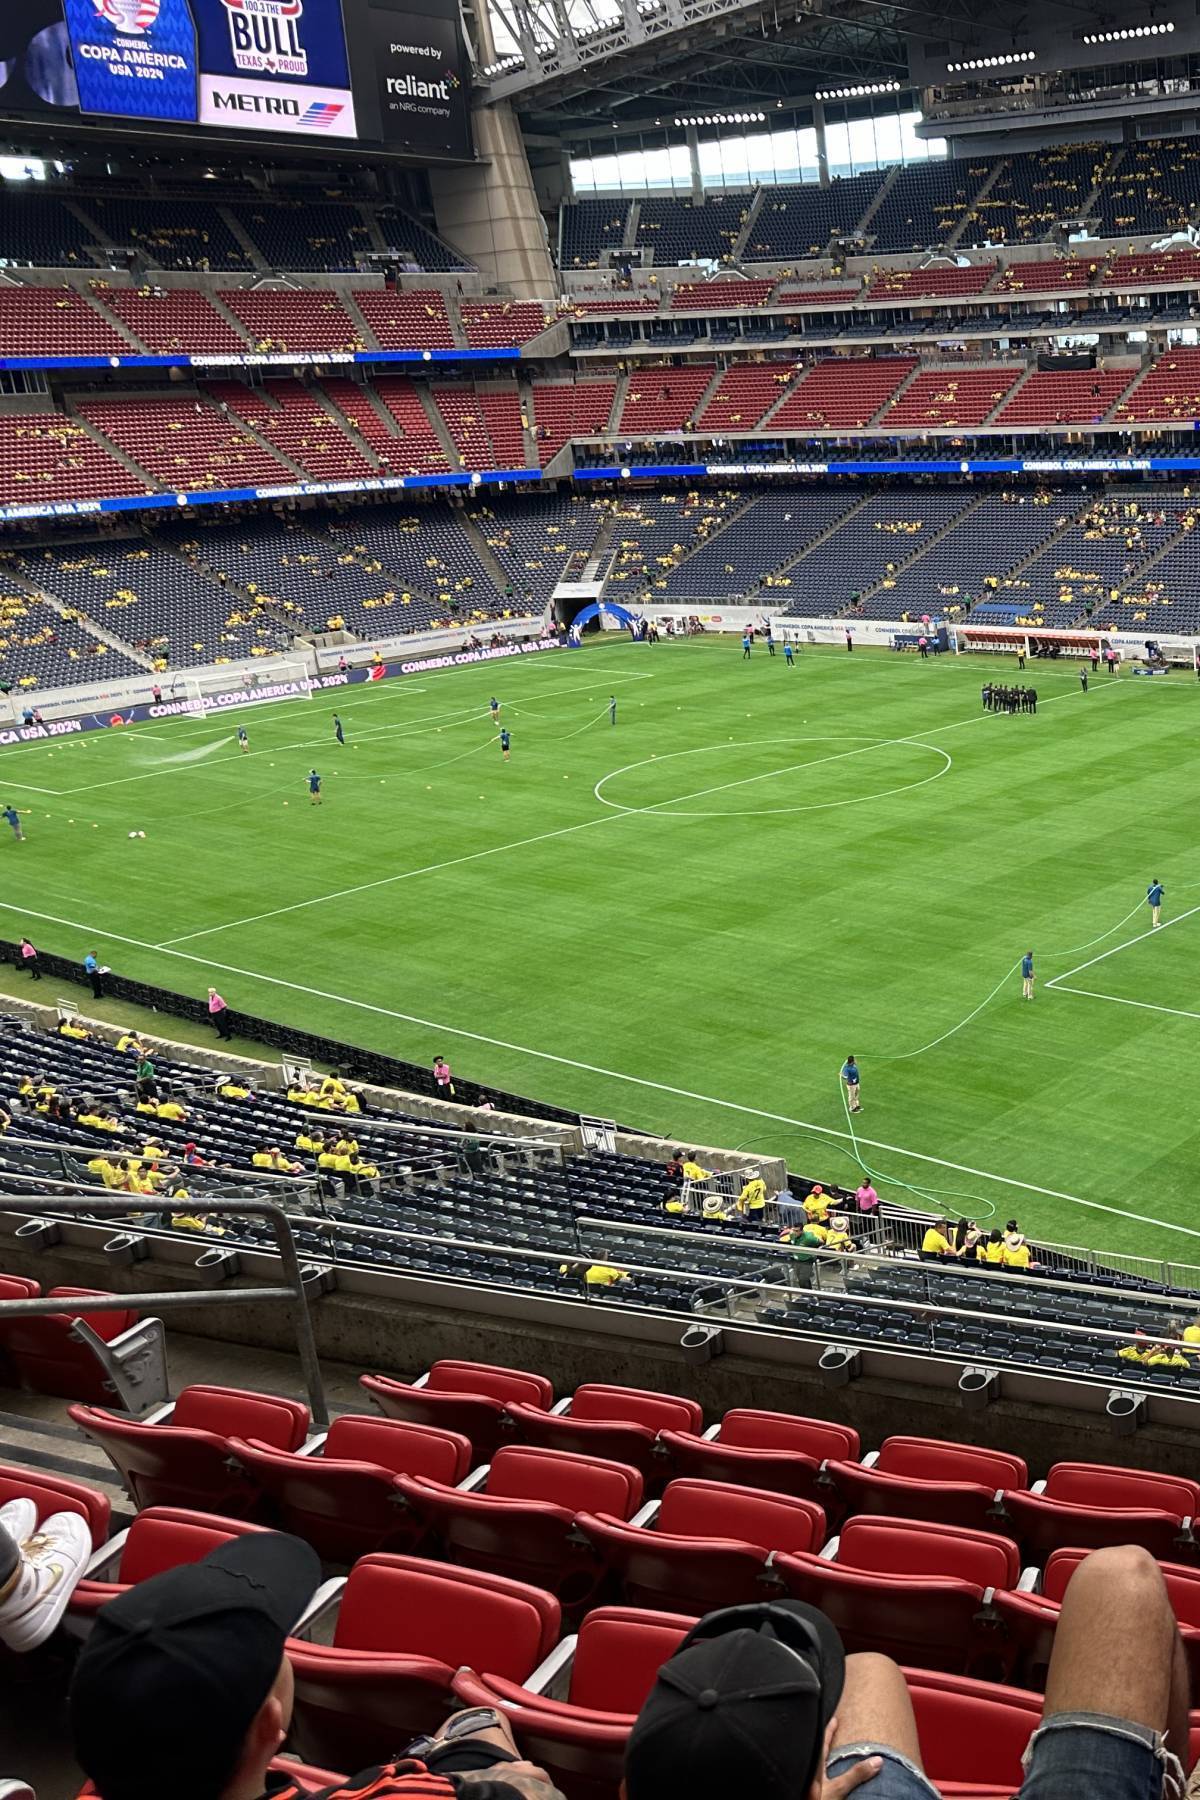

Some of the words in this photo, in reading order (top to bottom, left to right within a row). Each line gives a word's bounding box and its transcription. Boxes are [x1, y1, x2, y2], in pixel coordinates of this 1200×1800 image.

[244, 0, 265, 13] 100.3
[265, 3, 280, 15] THE
[231, 10, 304, 59] BULL
[80, 44, 121, 62] COPA
[122, 49, 187, 70] AMERICA
[390, 43, 430, 57] powered
[430, 47, 442, 60] by
[109, 63, 134, 77] USA
[134, 66, 164, 81] 2024
[236, 53, 263, 68] TEXAS
[278, 59, 305, 73] PROUD
[386, 74, 450, 100] reliant
[212, 90, 300, 117] METRO
[389, 102, 399, 110] an
[399, 102, 417, 112] NRG
[417, 105, 450, 118] company
[255, 487, 305, 498] CONMEBOL
[304, 484, 328, 494] COPA
[327, 481, 366, 493] AMERICA
[365, 480, 383, 490] USA
[383, 478, 405, 488] 2024
[6, 505, 55, 518] AMERICA
[54, 503, 76, 514] USA
[401, 656, 456, 674] CONMEBOL
[455, 651, 481, 665] COPA
[480, 644, 521, 661] AMERICA
[521, 641, 539, 653] USA
[539, 637, 560, 650] 2024
[149, 695, 217, 718] CONMEBOL
[217, 691, 250, 708] COPA
[250, 681, 300, 701] AMERICA
[300, 678, 322, 692] USA
[322, 674, 348, 689] 2024
[19, 725, 49, 740] USA
[48, 719, 81, 736] 2024
